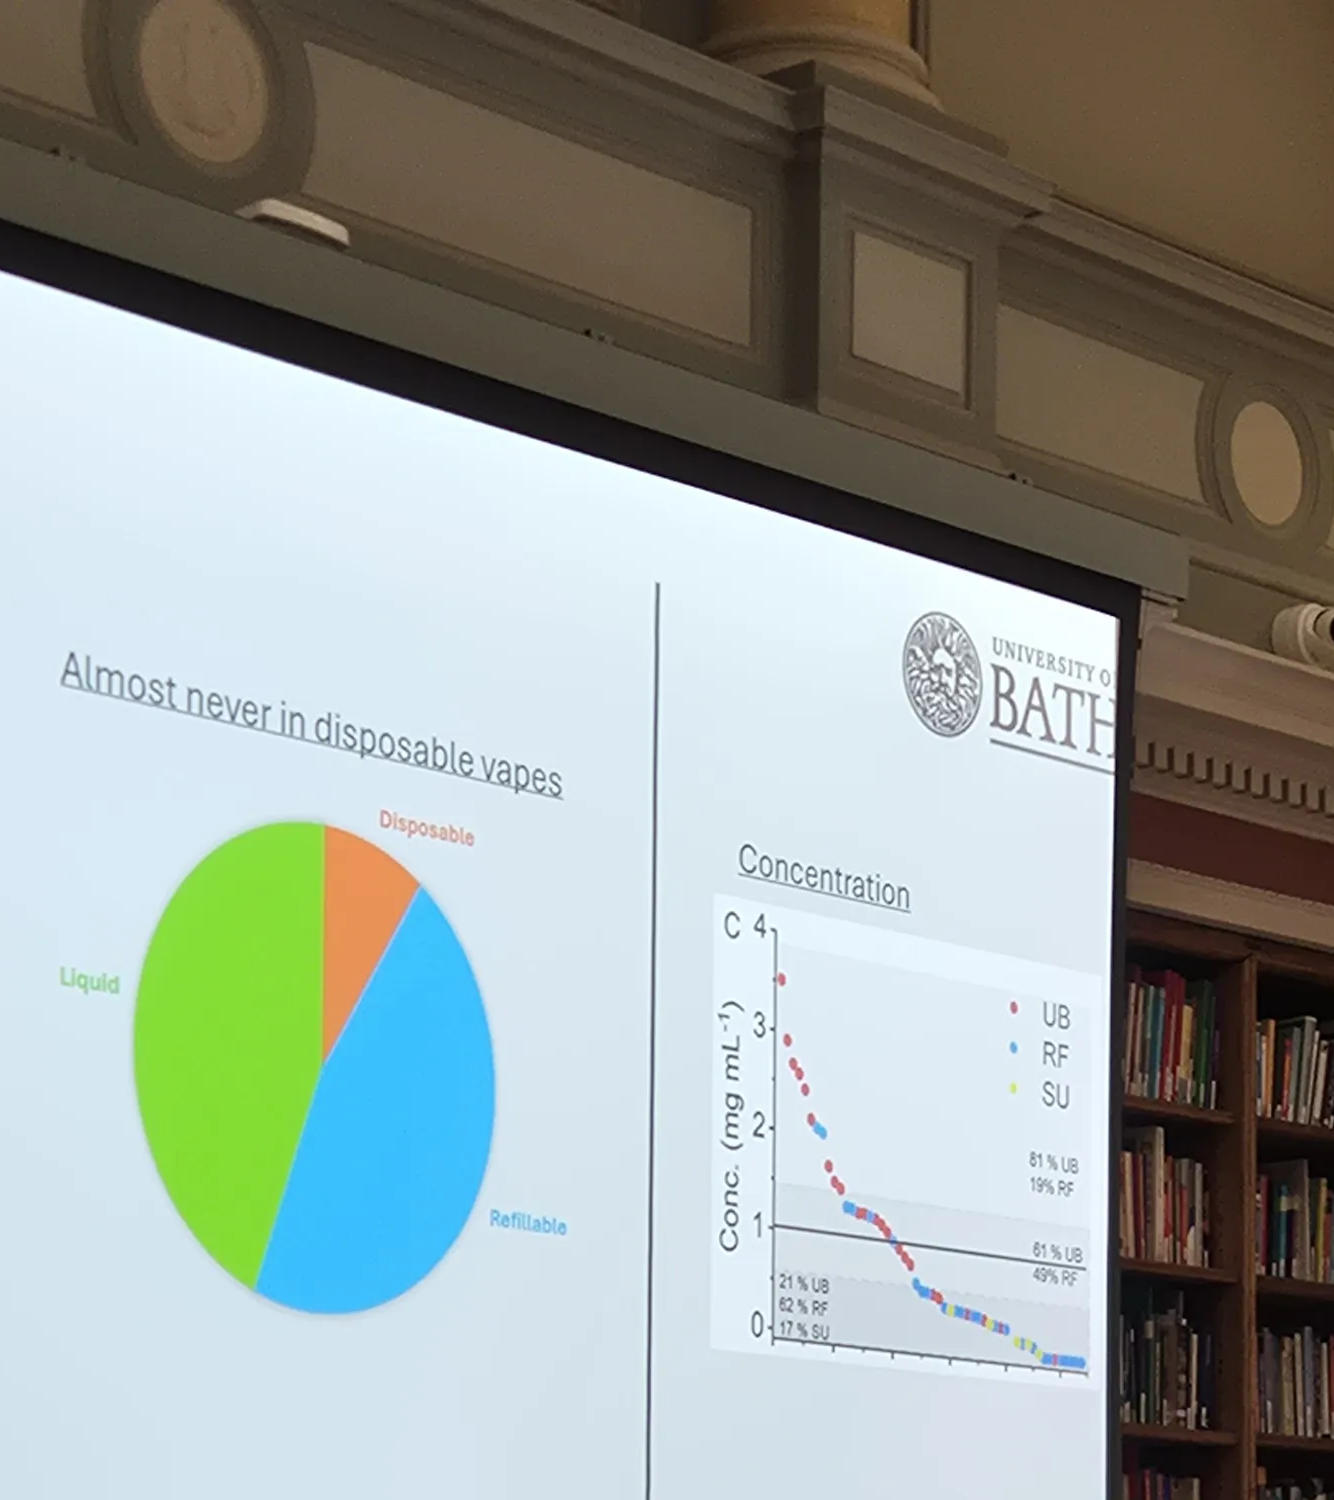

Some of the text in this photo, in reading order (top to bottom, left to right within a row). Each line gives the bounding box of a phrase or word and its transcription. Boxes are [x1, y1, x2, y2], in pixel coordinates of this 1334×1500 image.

[992, 636, 1116, 689] UNIVERSITY O
[61, 651, 563, 797] Almost never in disposable vapes
[989, 662, 1115, 759] BATH
[379, 809, 476, 847] Disposable
[738, 843, 912, 910] Concentration
[723, 911, 742, 940] C
[752, 913, 768, 939] 4
[59, 966, 121, 995] Liquid
[753, 1011, 767, 1038] 3
[1043, 1001, 1071, 1030] UB
[1042, 1041, 1070, 1068] RF
[1042, 1080, 1070, 1109] SU
[720, 1092, 745, 1151] (mg
[752, 1111, 766, 1139] 2
[1061, 1156, 1079, 1174] UB
[1058, 1180, 1074, 1197] RF
[718, 1164, 740, 1252] Conc.
[489, 1209, 568, 1237] Refillable
[753, 1211, 763, 1239] 1
[1065, 1247, 1083, 1263] UB
[779, 1273, 829, 1294] 21 % UB
[797, 1299, 808, 1314] %
[812, 1300, 828, 1316] RF
[751, 1310, 764, 1338] 0
[780, 1320, 829, 1340] 17 % SU
